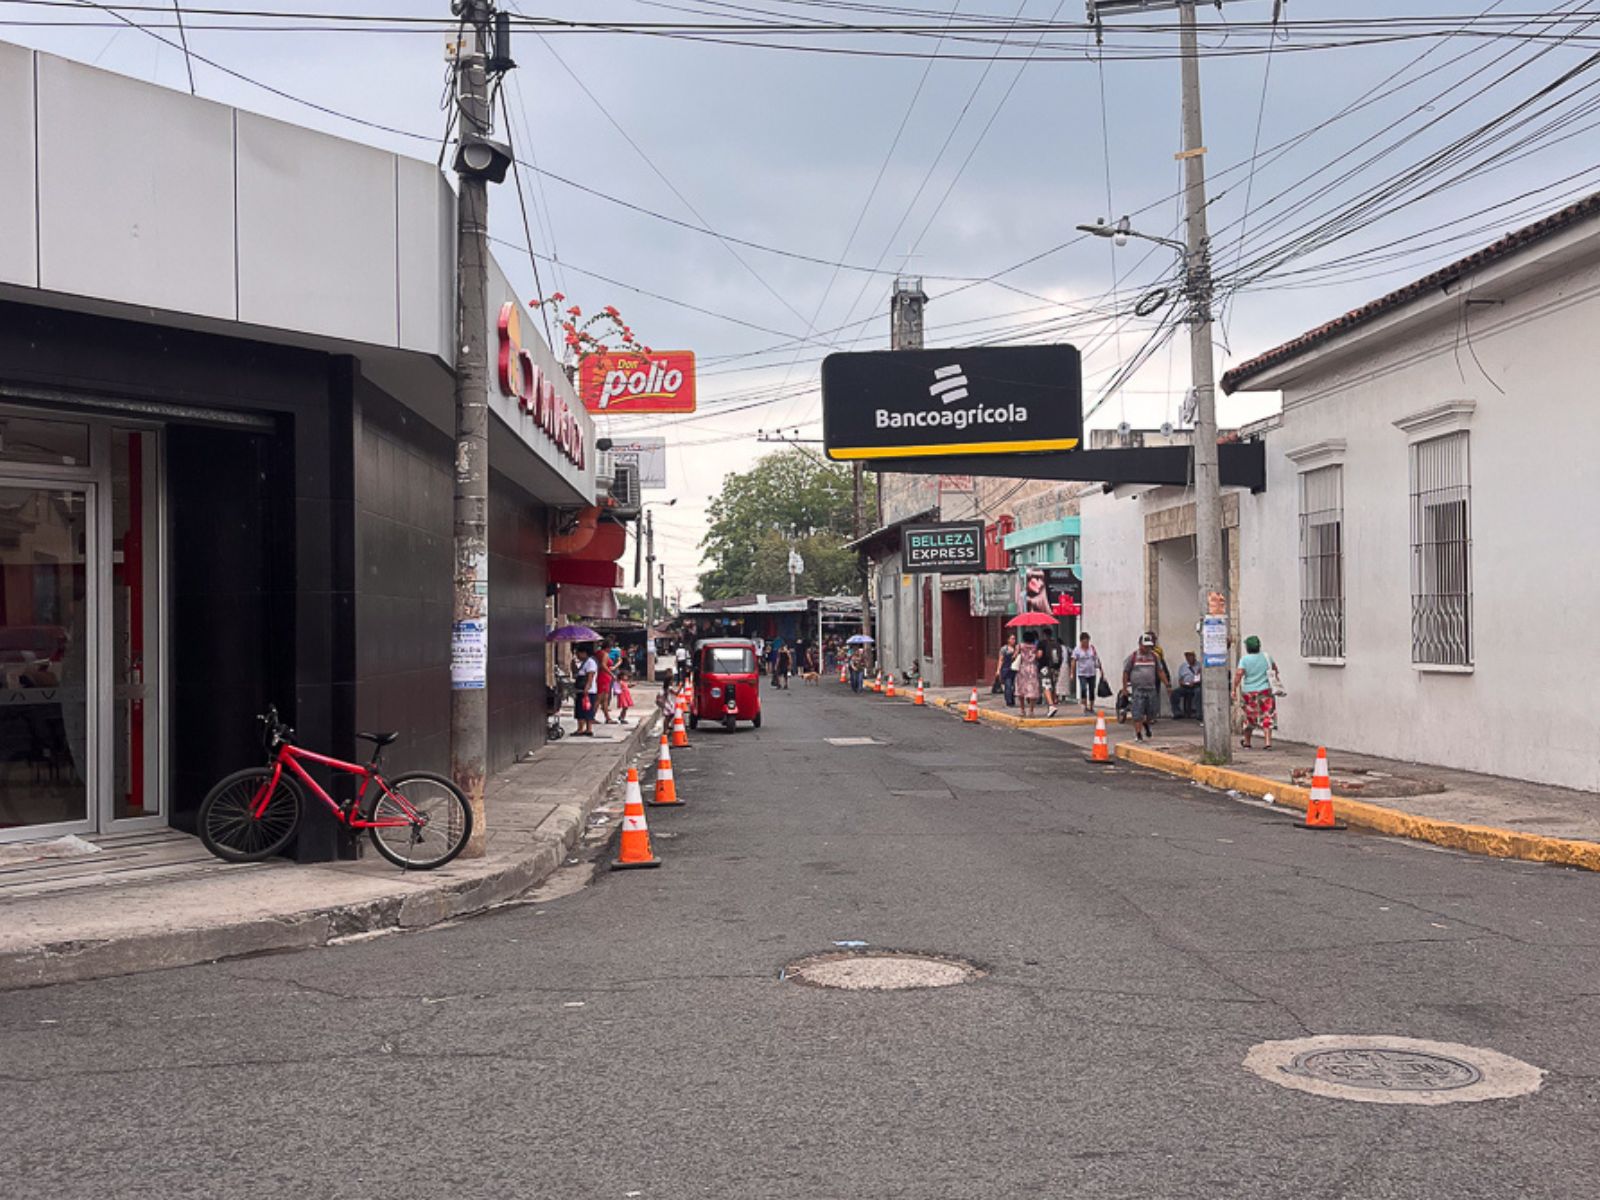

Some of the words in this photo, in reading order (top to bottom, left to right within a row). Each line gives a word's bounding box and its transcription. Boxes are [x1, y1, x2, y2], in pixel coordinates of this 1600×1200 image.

[875, 404, 1027, 429] Bancoagrícola
[912, 533, 973, 547] BELLEZA
[912, 548, 975, 560] EXPRESS
